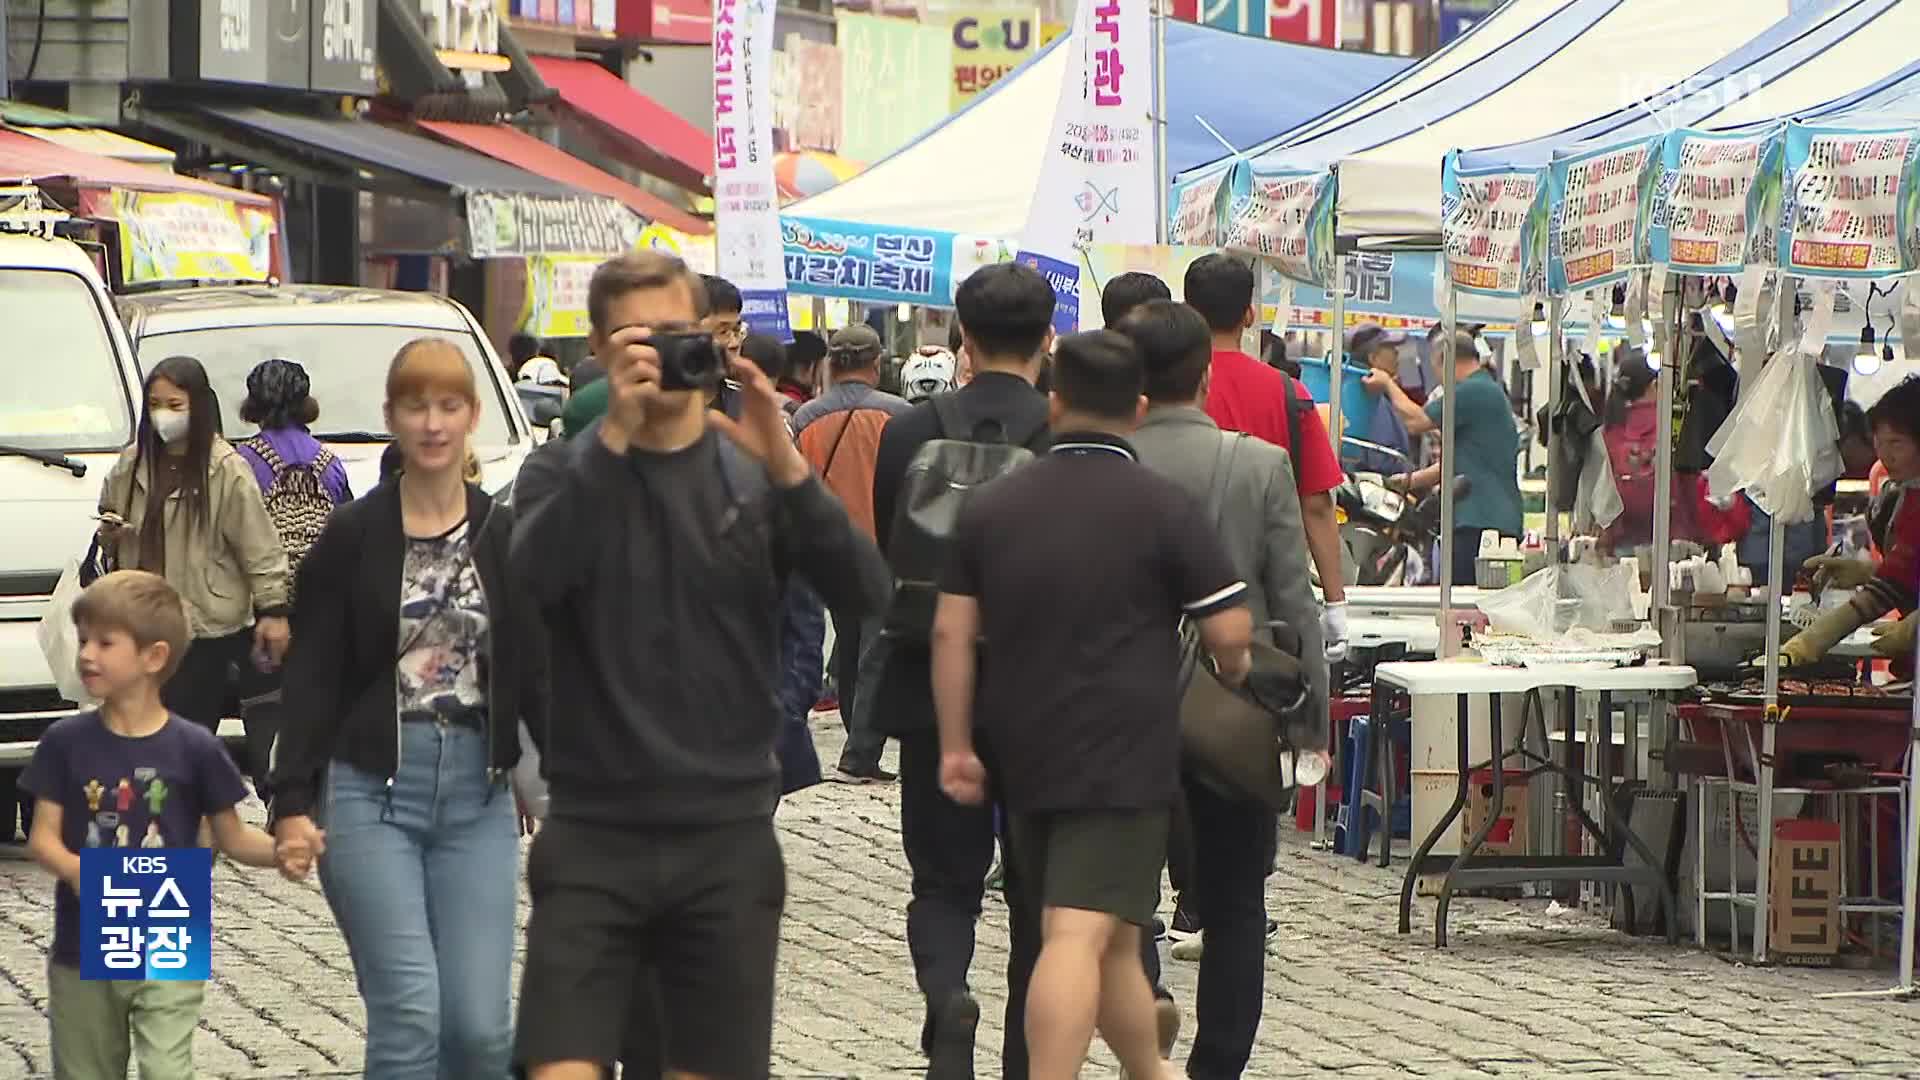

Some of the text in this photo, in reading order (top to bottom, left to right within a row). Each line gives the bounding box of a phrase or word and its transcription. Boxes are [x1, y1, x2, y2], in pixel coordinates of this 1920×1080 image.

[953, 17, 1030, 50] CU
[954, 64, 1014, 94] 편의
[875, 234, 934, 263] 부산
[784, 253, 932, 294] 자갈치 축제
[1790, 847, 1829, 945] LIFE
